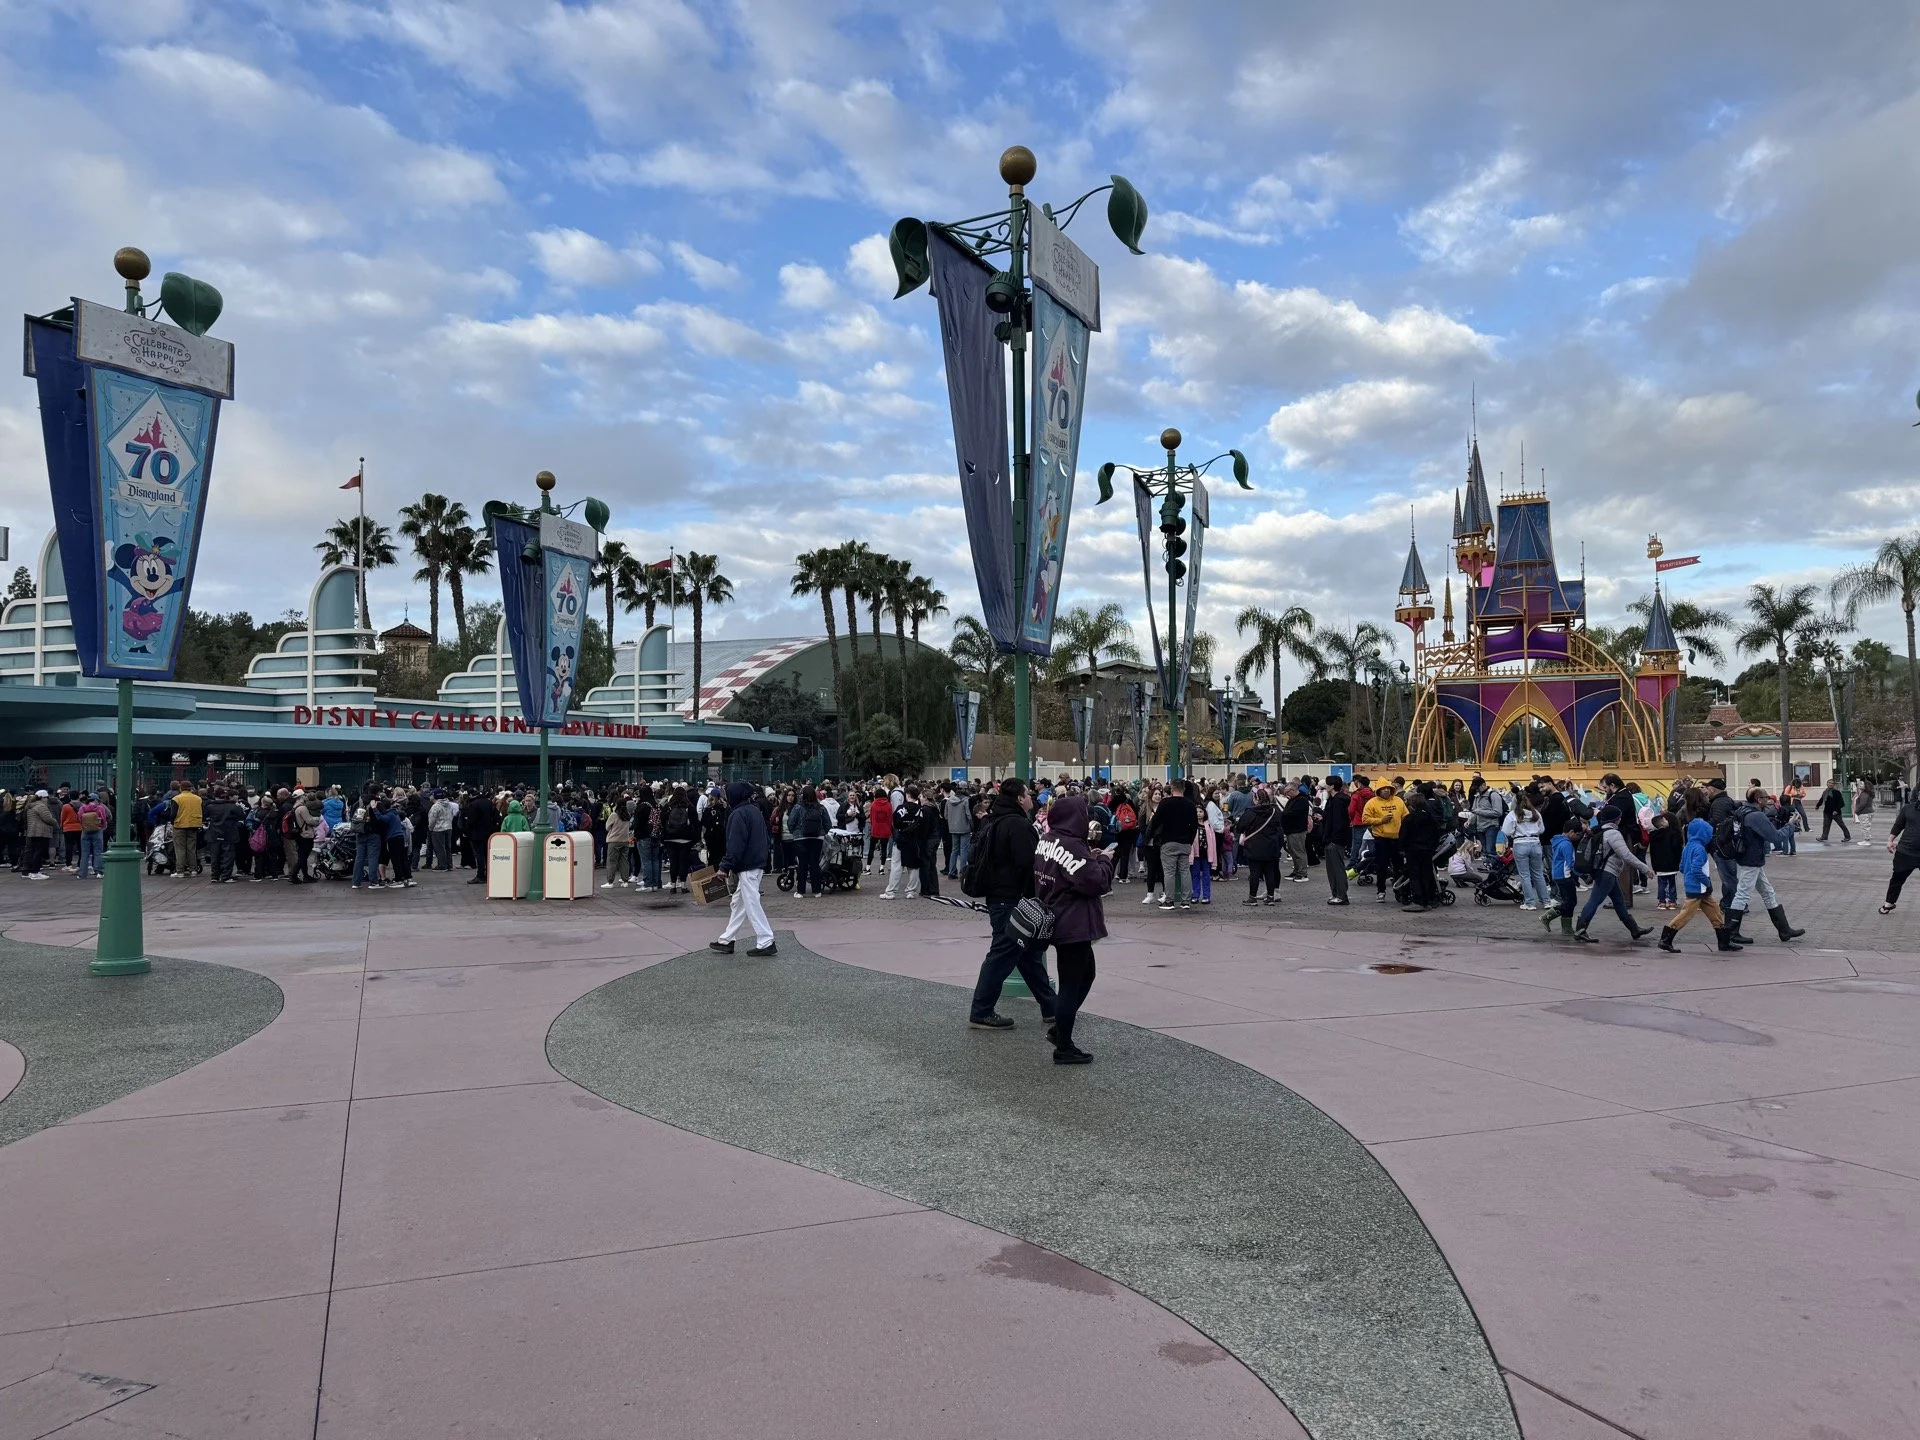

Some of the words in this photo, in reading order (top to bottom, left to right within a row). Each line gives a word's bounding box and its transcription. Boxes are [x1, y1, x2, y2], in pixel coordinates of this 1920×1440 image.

[132, 333, 183, 357] CELEBRATE
[142, 346, 174, 364] HAPPY
[1047, 378, 1070, 430] 70
[125, 441, 180, 485] 70
[127, 484, 176, 502] Disneyland
[556, 592, 577, 615] 70
[294, 705, 398, 728] DISNEY
[410, 710, 541, 734] CALIFORN
[558, 720, 649, 739] ADVENTURE
